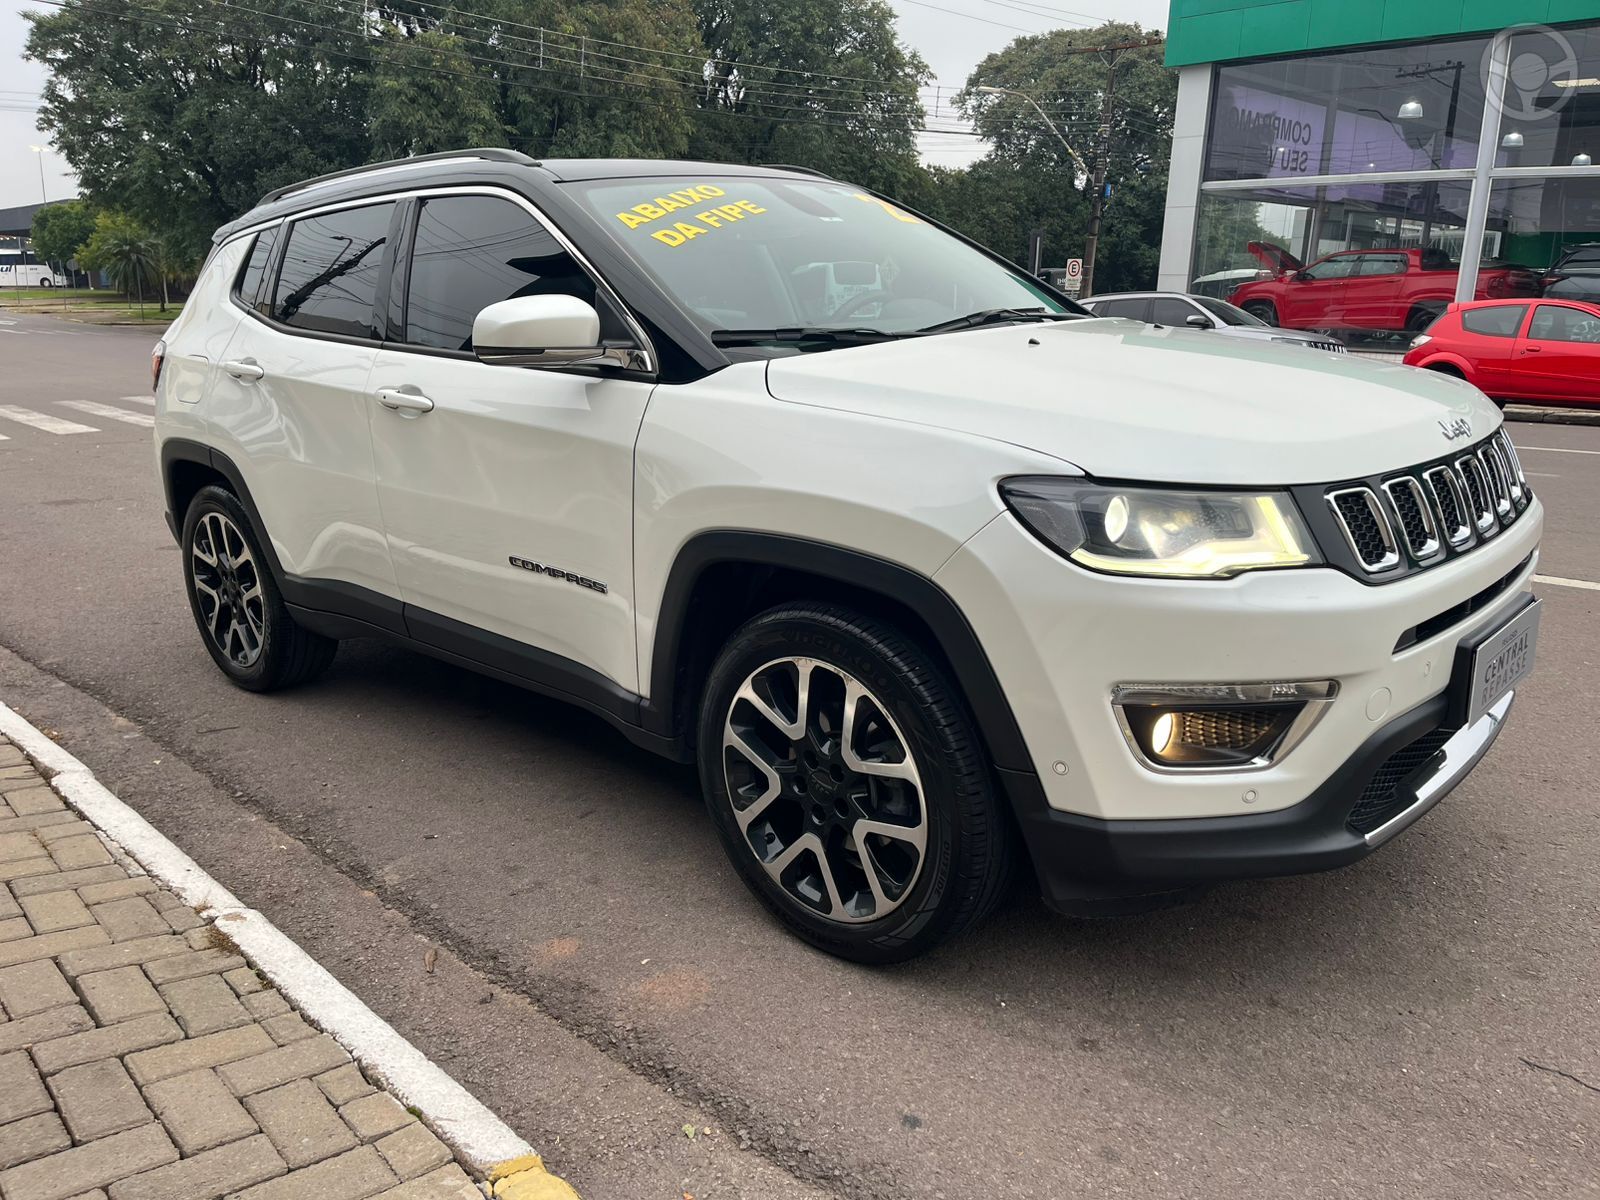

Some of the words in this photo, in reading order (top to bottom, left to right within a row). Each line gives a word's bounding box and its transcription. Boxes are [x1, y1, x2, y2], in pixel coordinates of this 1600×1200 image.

[616, 184, 726, 229] ABAIXO
[650, 221, 708, 247] DA
[695, 199, 767, 228] FIPE
[1071, 263, 1078, 274] E
[1438, 418, 1473, 440] Jeep
[508, 555, 609, 595] COMPASS
[1481, 651, 1528, 705] REPASSE
[1484, 632, 1529, 684] CENTRAL
